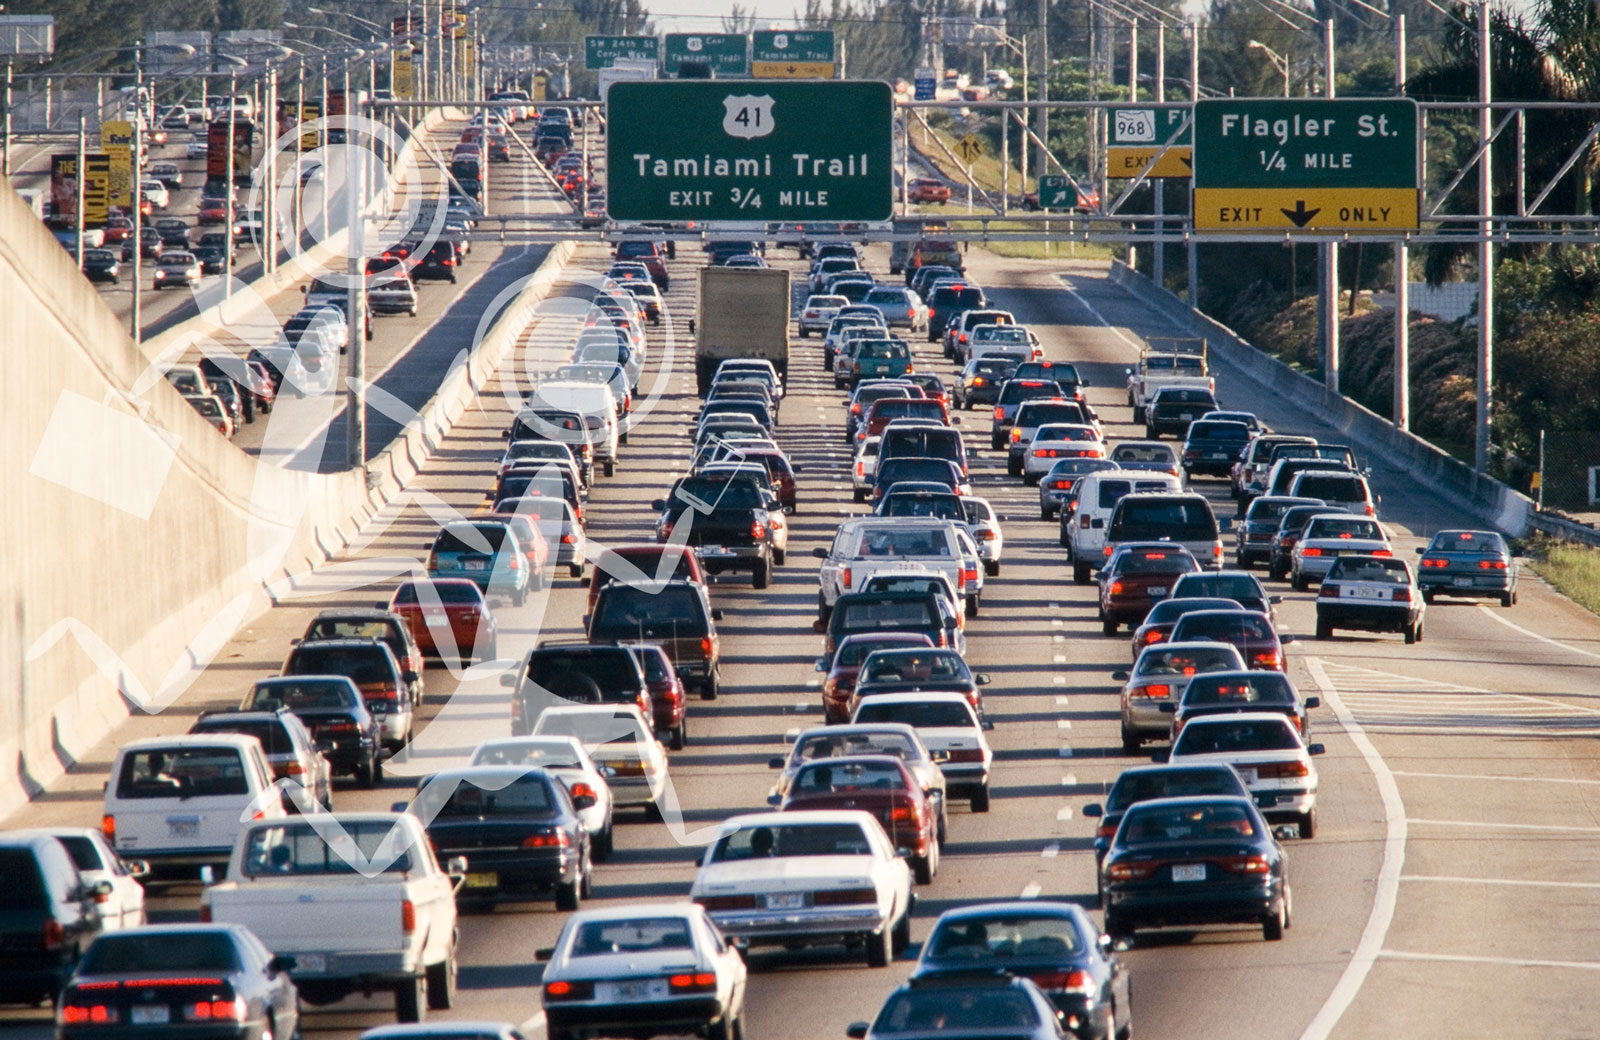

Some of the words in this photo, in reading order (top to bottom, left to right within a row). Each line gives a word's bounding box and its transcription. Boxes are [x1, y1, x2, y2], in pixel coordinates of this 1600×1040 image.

[612, 39, 636, 48] 24th
[643, 39, 654, 48] St
[671, 53, 713, 63] Tamiami
[718, 53, 741, 63] Trail
[759, 50, 800, 60] Tamiami
[806, 50, 829, 60] Trail
[735, 106, 761, 127] 41
[1118, 121, 1145, 135] 968
[1222, 114, 1336, 146] Flagler
[1357, 113, 1398, 137] St.
[110, 133, 131, 144] Fair
[58, 160, 76, 174] THE
[633, 153, 771, 177] Tamiami
[792, 153, 867, 176] Trail
[1124, 156, 1156, 168] EXI
[1259, 150, 1287, 171] 1/4
[1305, 153, 1353, 169] MILE
[669, 190, 713, 206] EXIT
[730, 187, 762, 209] 3/4
[779, 190, 828, 206] MILE
[1219, 207, 1263, 222] EXIT
[1339, 207, 1391, 222] ONLY
